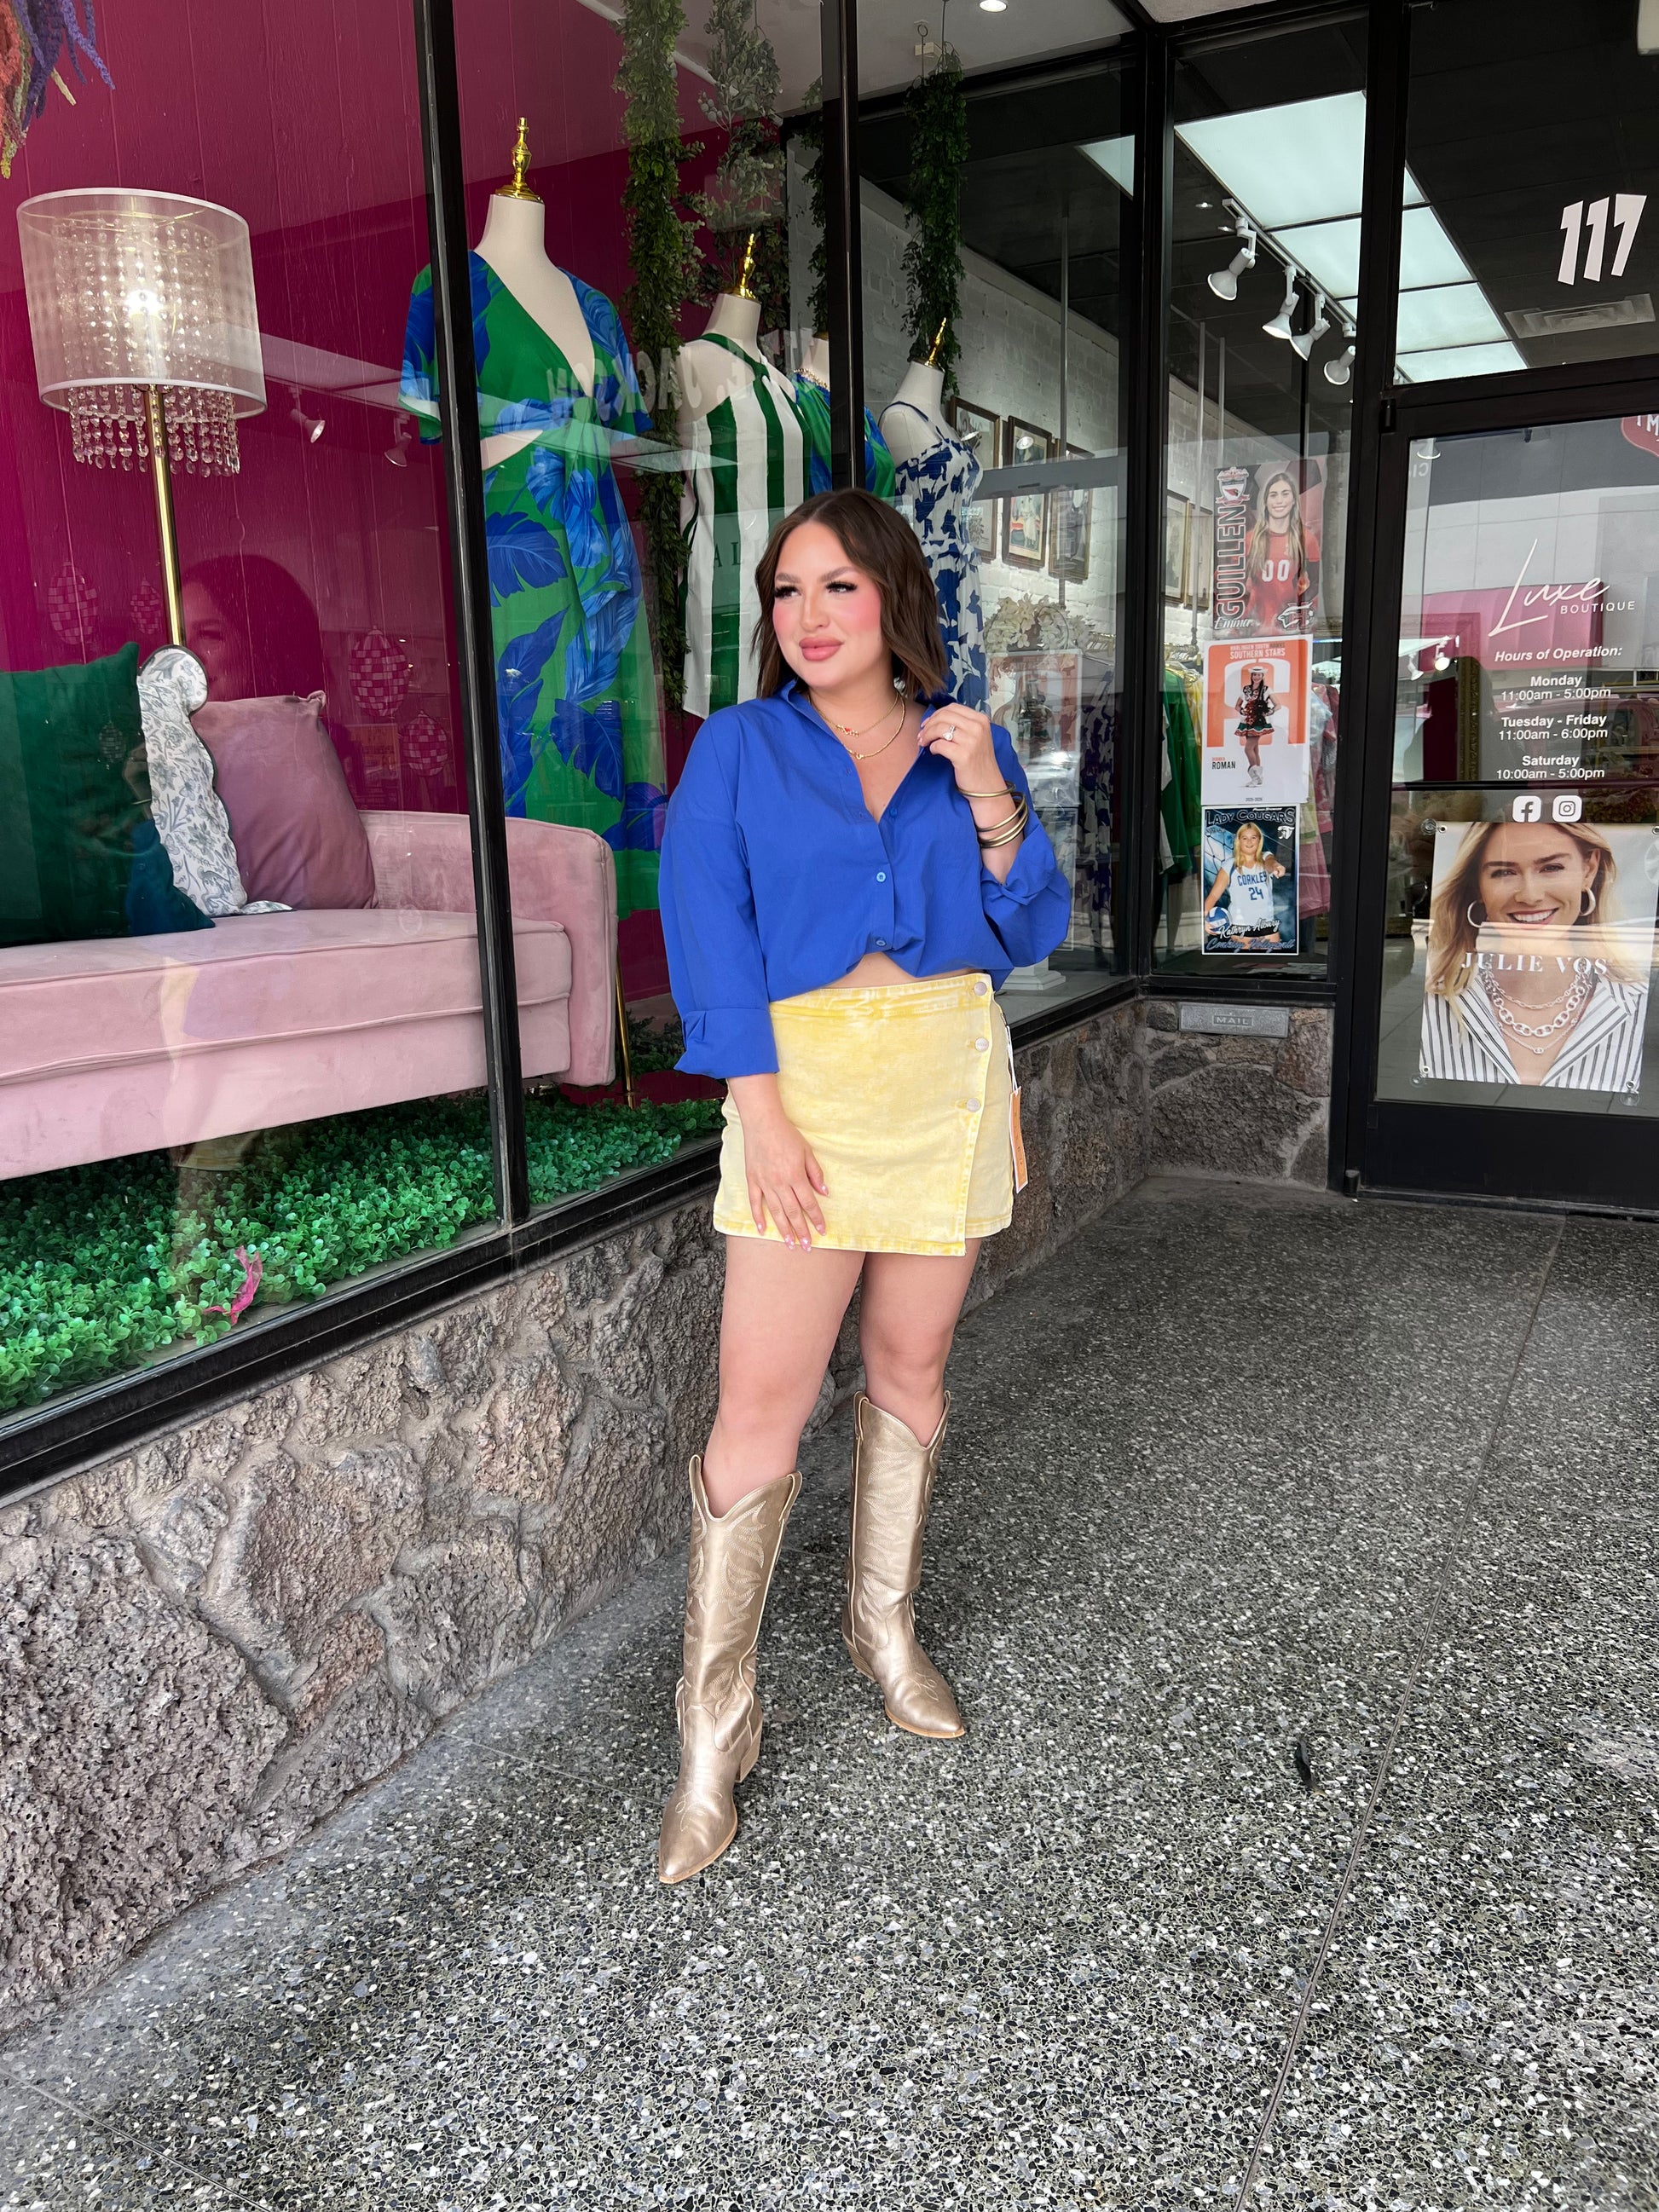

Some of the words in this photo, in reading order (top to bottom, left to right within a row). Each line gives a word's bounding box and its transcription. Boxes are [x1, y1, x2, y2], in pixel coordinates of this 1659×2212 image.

[1558, 193, 1647, 286] 117
[1217, 505, 1246, 620] GUILLEN
[1488, 539, 1610, 637] Luxe
[1560, 601, 1635, 615] BOUTIQUE
[1229, 650, 1263, 660] SOUTHERN
[1265, 648, 1286, 657] STARS
[1494, 650, 1533, 662] Hours
[1536, 649, 1549, 661] of
[1552, 646, 1622, 662] Operation:
[1530, 675, 1582, 688] Monday
[1501, 690, 1552, 702] 11:00am
[1564, 688, 1611, 701] 5:00pm
[1501, 716, 1554, 729] Tuesday
[1566, 714, 1607, 727] Friday
[1499, 730, 1550, 741] 11:00am
[1561, 728, 1608, 741] 6:00pm
[1211, 761, 1236, 770] ROMAN
[1522, 755, 1580, 767] Saturday
[1496, 769, 1547, 779] 10:00am
[1558, 768, 1605, 781] 5:00pm
[1248, 887, 1264, 901] 24
[1461, 951, 1543, 973] JULIE
[1555, 956, 1608, 974] VOS
[1215, 1015, 1249, 1026] MAIL
